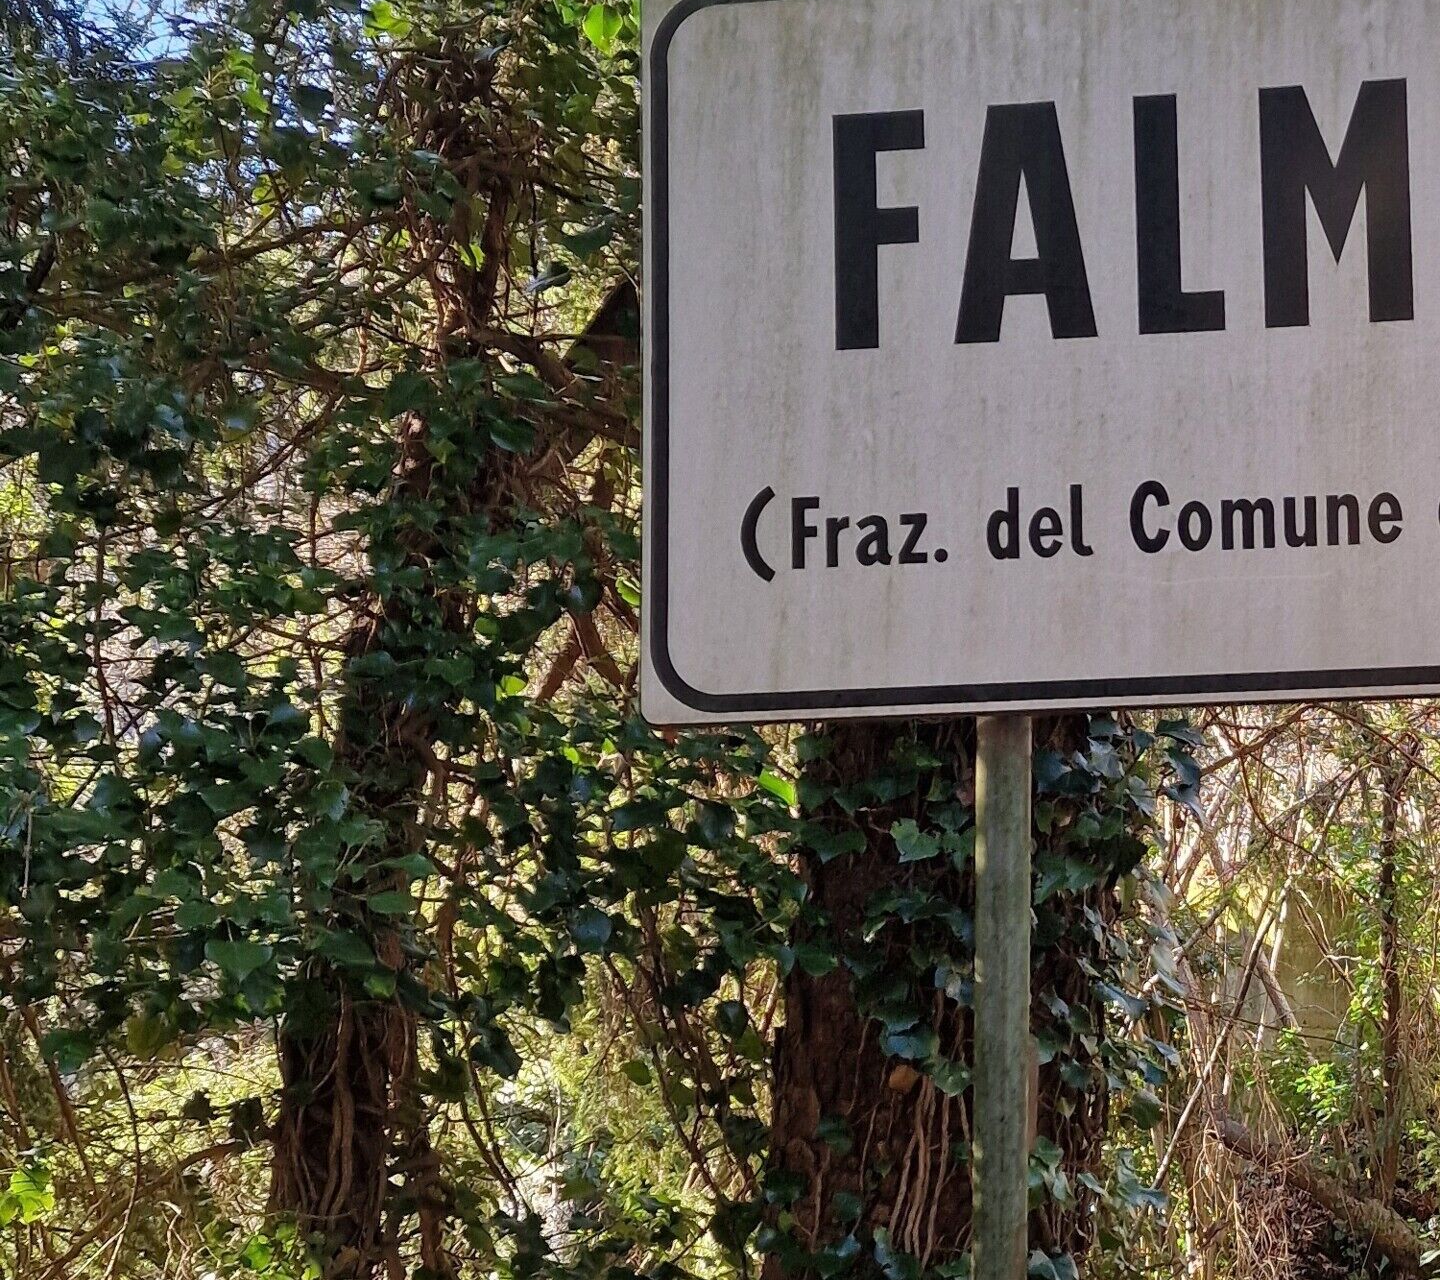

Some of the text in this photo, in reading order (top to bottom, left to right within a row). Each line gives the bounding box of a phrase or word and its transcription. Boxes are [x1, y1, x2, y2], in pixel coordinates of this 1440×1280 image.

[740, 485, 949, 583] (Fraz.
[986, 483, 1094, 561] del
[1129, 480, 1404, 554] Comune
